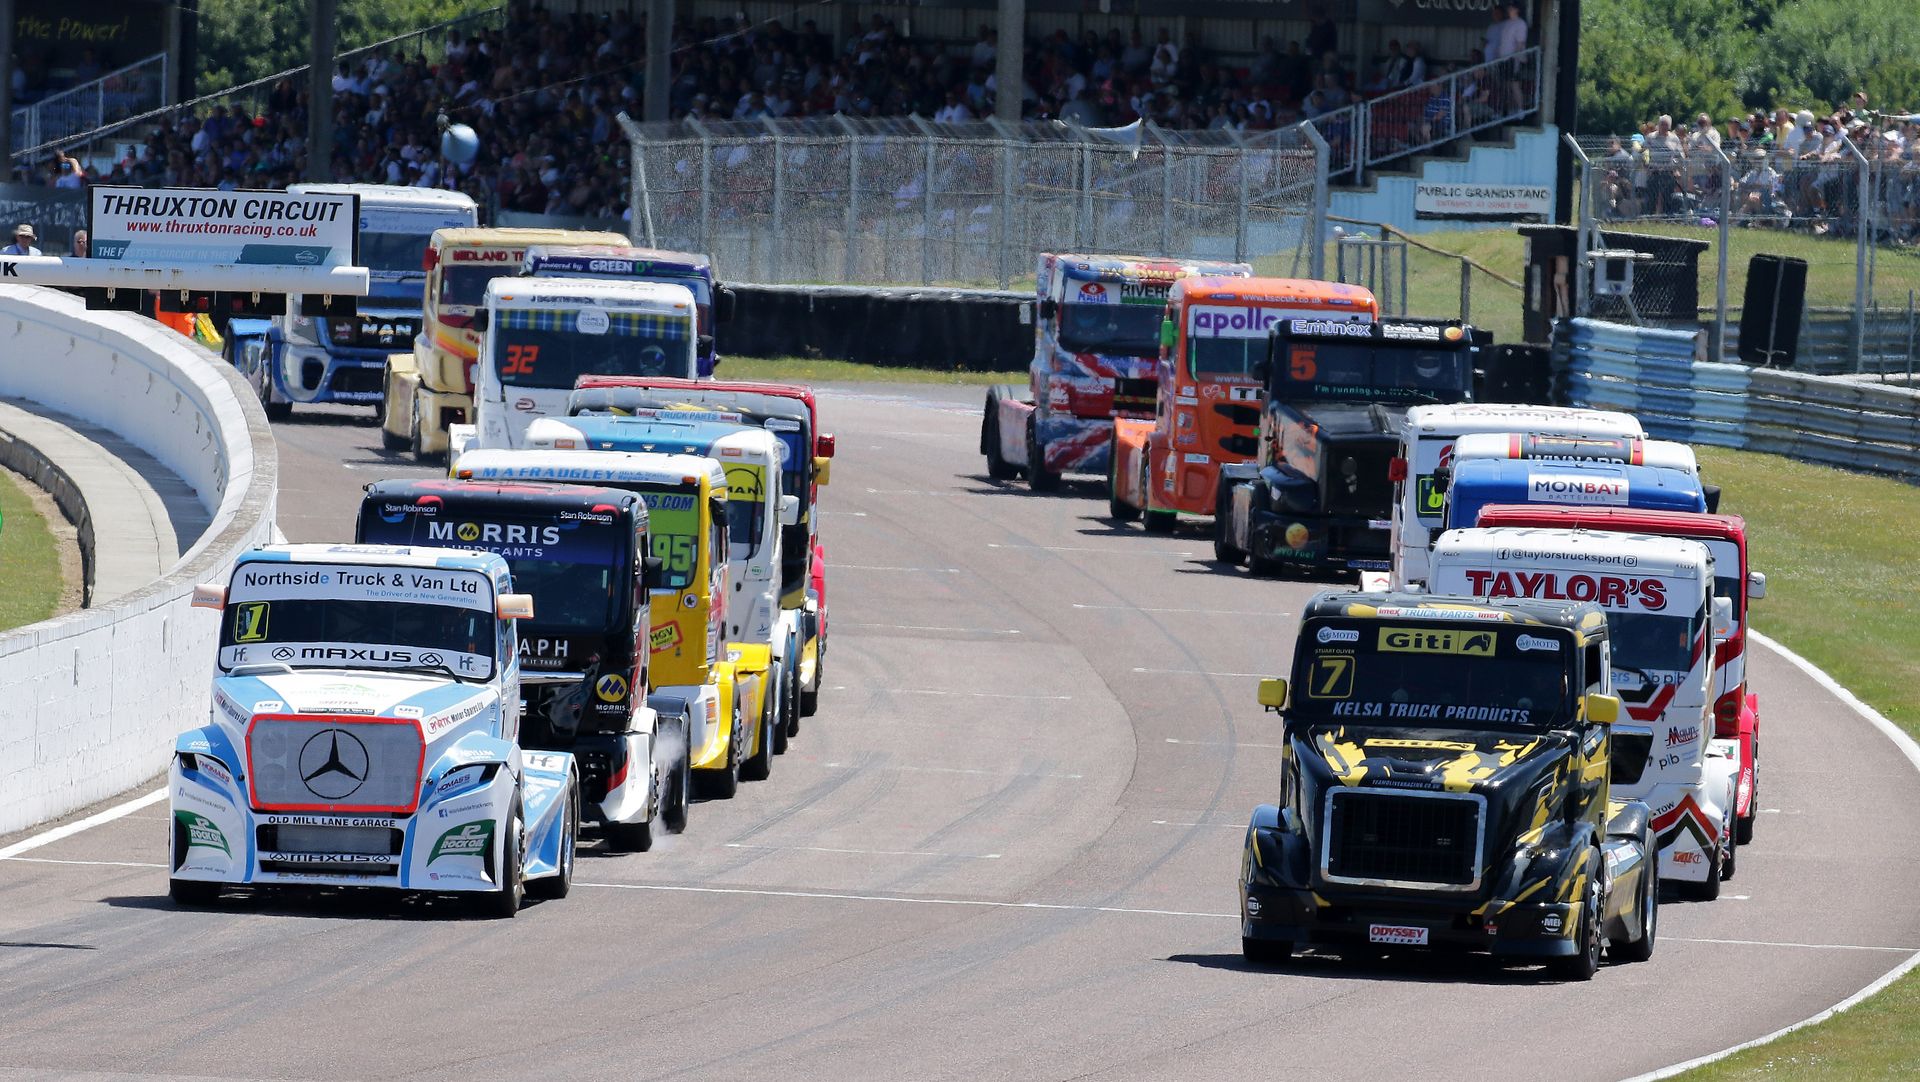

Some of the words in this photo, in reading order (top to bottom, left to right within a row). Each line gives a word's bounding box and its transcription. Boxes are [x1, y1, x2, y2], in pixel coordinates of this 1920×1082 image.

[17, 15, 51, 39] the
[57, 15, 130, 41] Power!
[1417, 186, 1461, 197] PUBLIC
[1465, 187, 1550, 200] GRANDSTAND
[102, 194, 240, 219] THRUXTON
[243, 198, 343, 221] CIRCUIT
[126, 219, 318, 238] www.thruxtonracing.co.uk
[98, 246, 117, 257] THE
[118, 247, 159, 258] FASTEST
[160, 248, 198, 259] CIRCUIT
[210, 249, 230, 260] THE
[0, 261, 18, 277] K
[589, 260, 632, 273] GREEN
[361, 323, 412, 336] MAN
[1291, 319, 1372, 336] Eminox
[502, 345, 539, 374] 32
[1290, 350, 1318, 381] 5
[659, 411, 688, 420] TRUCK
[689, 412, 718, 421] PARTS
[482, 467, 497, 477] M
[499, 468, 512, 477] A
[513, 468, 615, 480] FRAUGLEY
[1535, 480, 1623, 495] MONBAT
[1548, 494, 1606, 502] BATTERIES
[385, 503, 401, 513] Stan
[402, 504, 437, 514] Robinson
[560, 510, 577, 520] Stan
[577, 512, 613, 522] Robinson
[428, 521, 560, 546] MORRIS
[652, 534, 692, 572] 95
[1512, 548, 1622, 565] @taylorstrucksport
[244, 571, 330, 587] Northside
[336, 571, 385, 587] Truck
[391, 573, 404, 588] &
[411, 574, 444, 590] Van
[450, 577, 478, 594] Ltd
[1465, 569, 1667, 611] TAYLOR'S
[366, 589, 380, 597] The
[381, 590, 402, 598] Driver
[437, 594, 478, 605] Generation
[1378, 608, 1400, 616] imex
[1404, 609, 1437, 618] TRUCK
[1438, 610, 1474, 619] PARTS
[1478, 612, 1501, 620] imex
[240, 604, 264, 640] 1
[1332, 631, 1358, 640] MOTIS
[1386, 631, 1451, 650] Giti
[1532, 640, 1559, 649] MOTIS
[301, 647, 412, 663] MAXUS
[1320, 658, 1348, 694] 7
[451, 709, 465, 724] Motor
[1333, 702, 1382, 717] KELSA
[1388, 703, 1439, 718] TRUCK
[1445, 705, 1529, 723] PRODUCTS
[1657, 801, 1675, 816] TOW
[268, 816, 289, 824] OLD
[293, 817, 318, 825] MILL
[322, 818, 349, 826] LANE
[352, 818, 396, 827] GARAGE
[441, 838, 468, 850] ROCK
[290, 854, 370, 862] MAXUS
[1371, 926, 1426, 939] ODYSSEY
